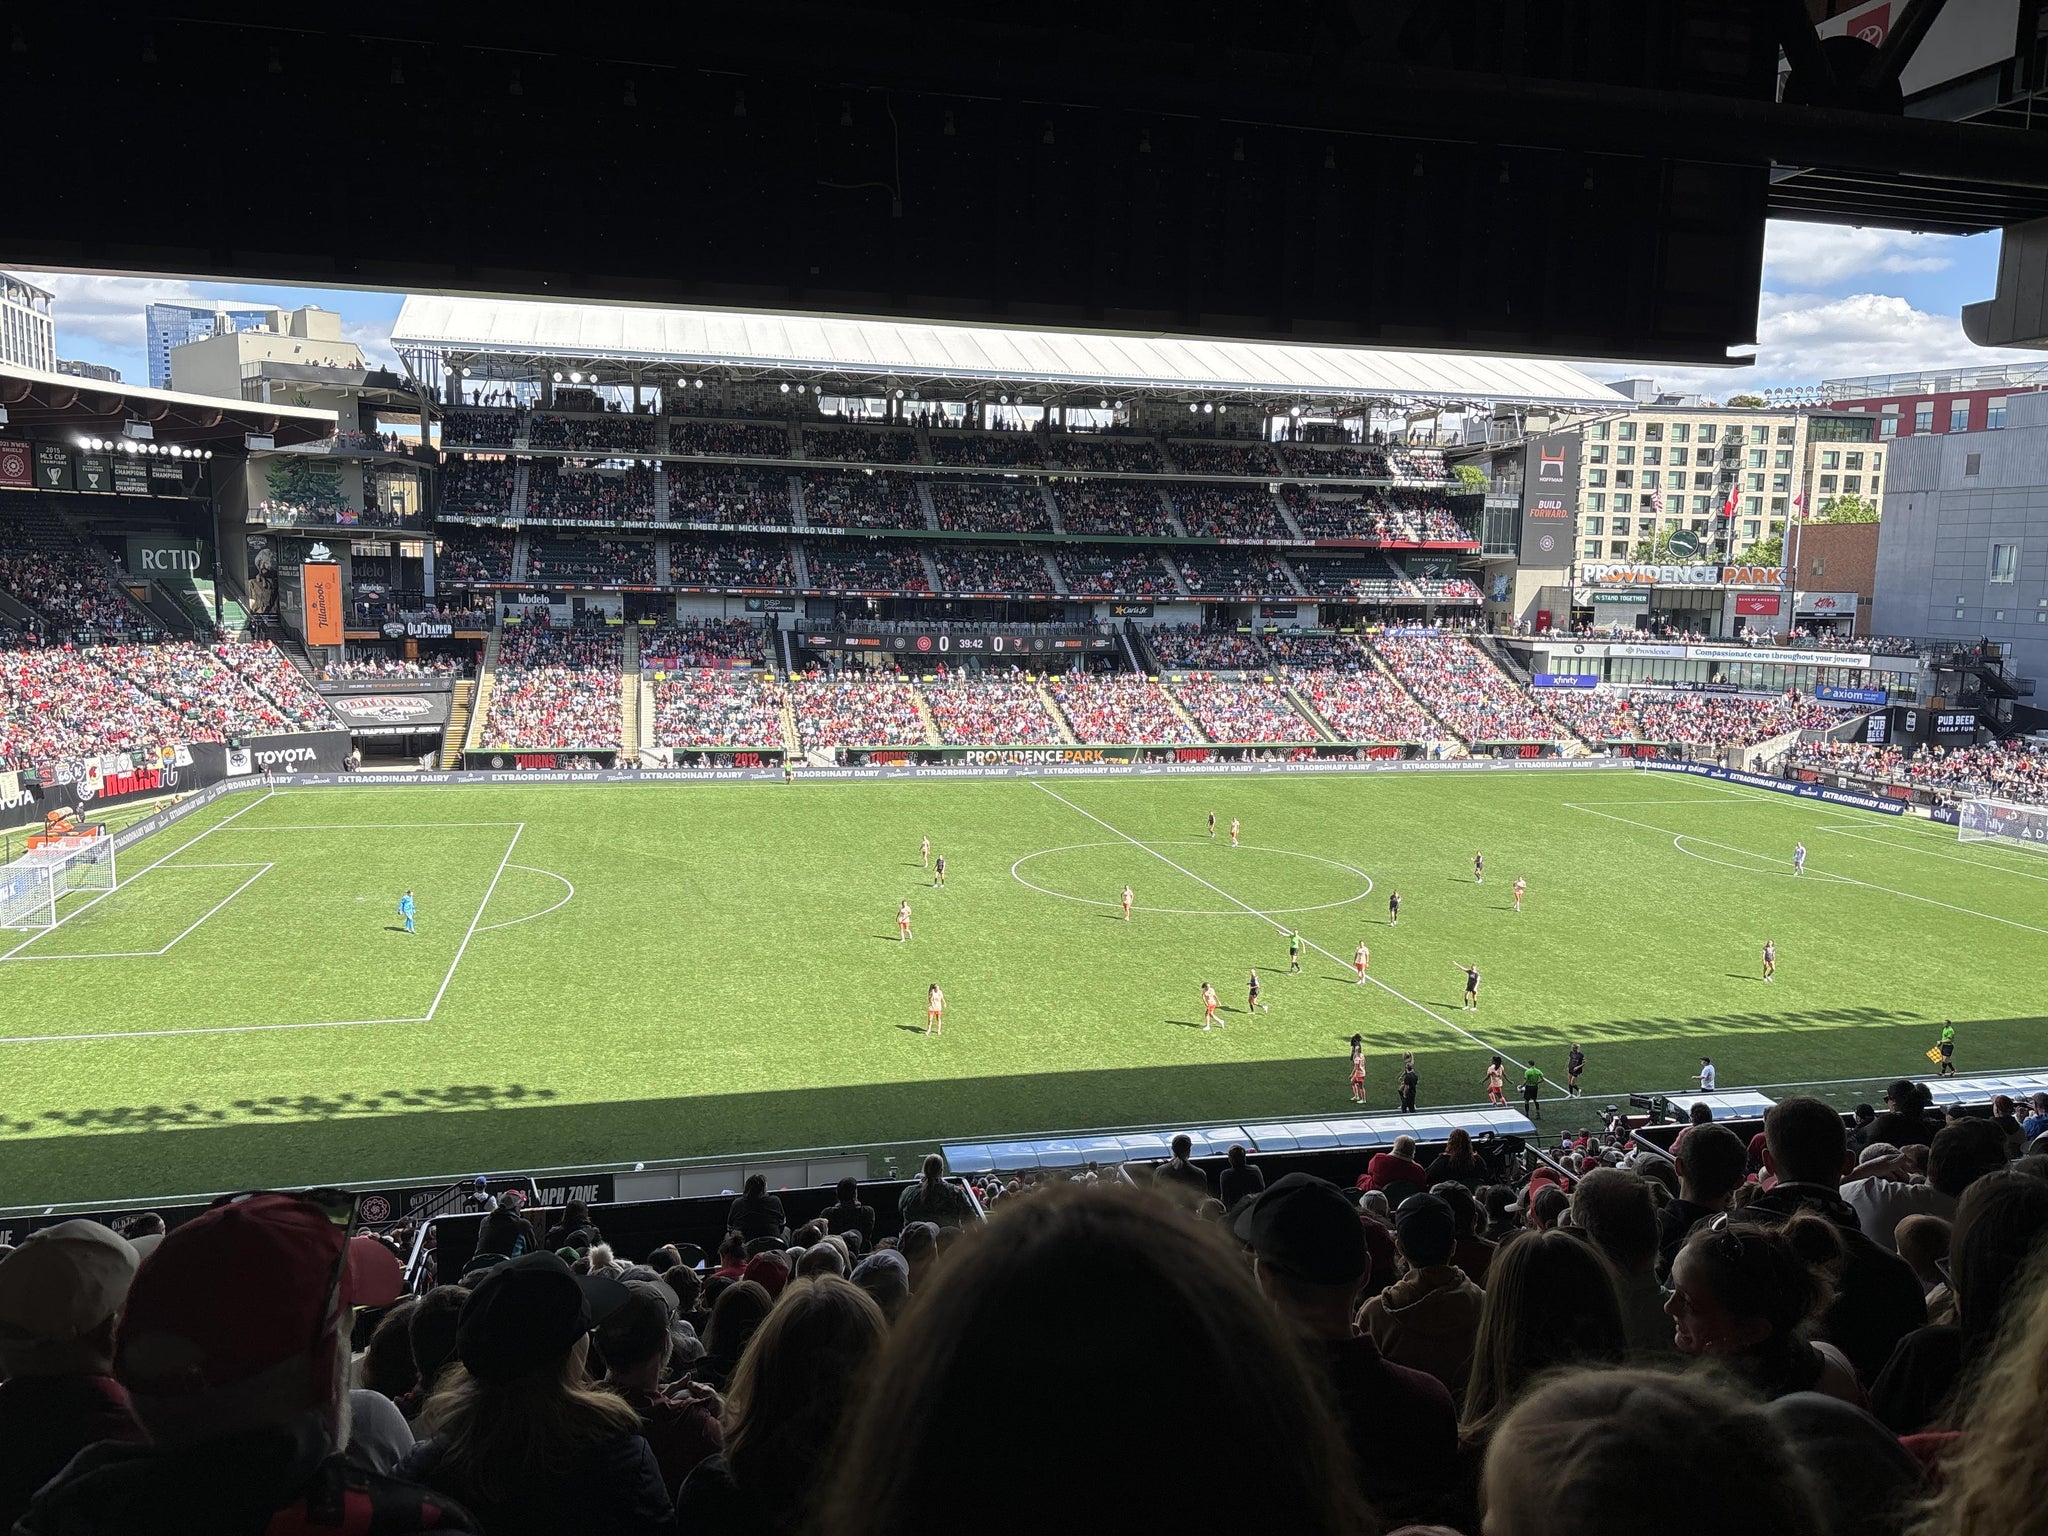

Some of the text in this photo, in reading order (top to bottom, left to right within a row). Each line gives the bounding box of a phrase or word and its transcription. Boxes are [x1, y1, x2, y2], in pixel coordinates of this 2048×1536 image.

[152, 472, 182, 480] CHAMPIONS
[1538, 500, 1562, 509] BUILD
[1530, 508, 1568, 518] FORWARD.
[446, 515, 497, 524] RING HONOR
[504, 518, 547, 526] JOHN BAIN
[552, 518, 616, 528] CLIVE CHARLES
[621, 520, 682, 530] JIMMY CONWAY
[688, 522, 718, 530] TIMBER
[738, 524, 787, 533] MICK HOBAN
[792, 526, 845, 535] DIEGO VALERI
[142, 549, 200, 570] RCTID
[352, 562, 384, 577] odelo
[1584, 564, 1783, 586] PROVIDENCE PARK
[518, 593, 550, 604] Modelo
[315, 582, 328, 628] Tillamook
[939, 636, 949, 651] 0
[959, 639, 983, 648] 39:42
[993, 637, 1003, 652] 0
[1695, 648, 1751, 659] Compassionate
[1771, 652, 1813, 663] throughout
[1815, 656, 1832, 664] your
[1833, 656, 1862, 665] journey
[1553, 676, 1578, 685] xfinity
[1832, 689, 1862, 700] axiom
[1868, 720, 1886, 730] PUB
[1938, 715, 1975, 725] PUB BEER
[1867, 730, 1885, 738] BEER
[255, 748, 316, 764] TOYOTA
[1176, 749, 1209, 762] THORNS
[1520, 746, 1539, 758] 2012
[514, 754, 556, 768] THORNS
[735, 753, 759, 767] 2012
[1044, 767, 1107, 775] EXTRAORDINARY
[1167, 765, 1229, 773] EXTRAORDINARY
[1287, 763, 1370, 772] EXTRAORDINARY DAIRY
[1622, 760, 1709, 774] EXTRAORDINARY DAIRY
[338, 774, 449, 783] EXTRAORDINARY DAIRY
[782, 770, 851, 778] ETRAORDINARY
[301, 777, 331, 785] Tillamook
[1729, 772, 1797, 792] EXTRAORDINARY DAIRY
[1822, 791, 1901, 812] EXTRAORDINARY DAIRY
[1934, 808, 1952, 822] ally
[114, 826, 144, 849] XTRAORDINARY
[568, 1184, 599, 1203] ZONE
